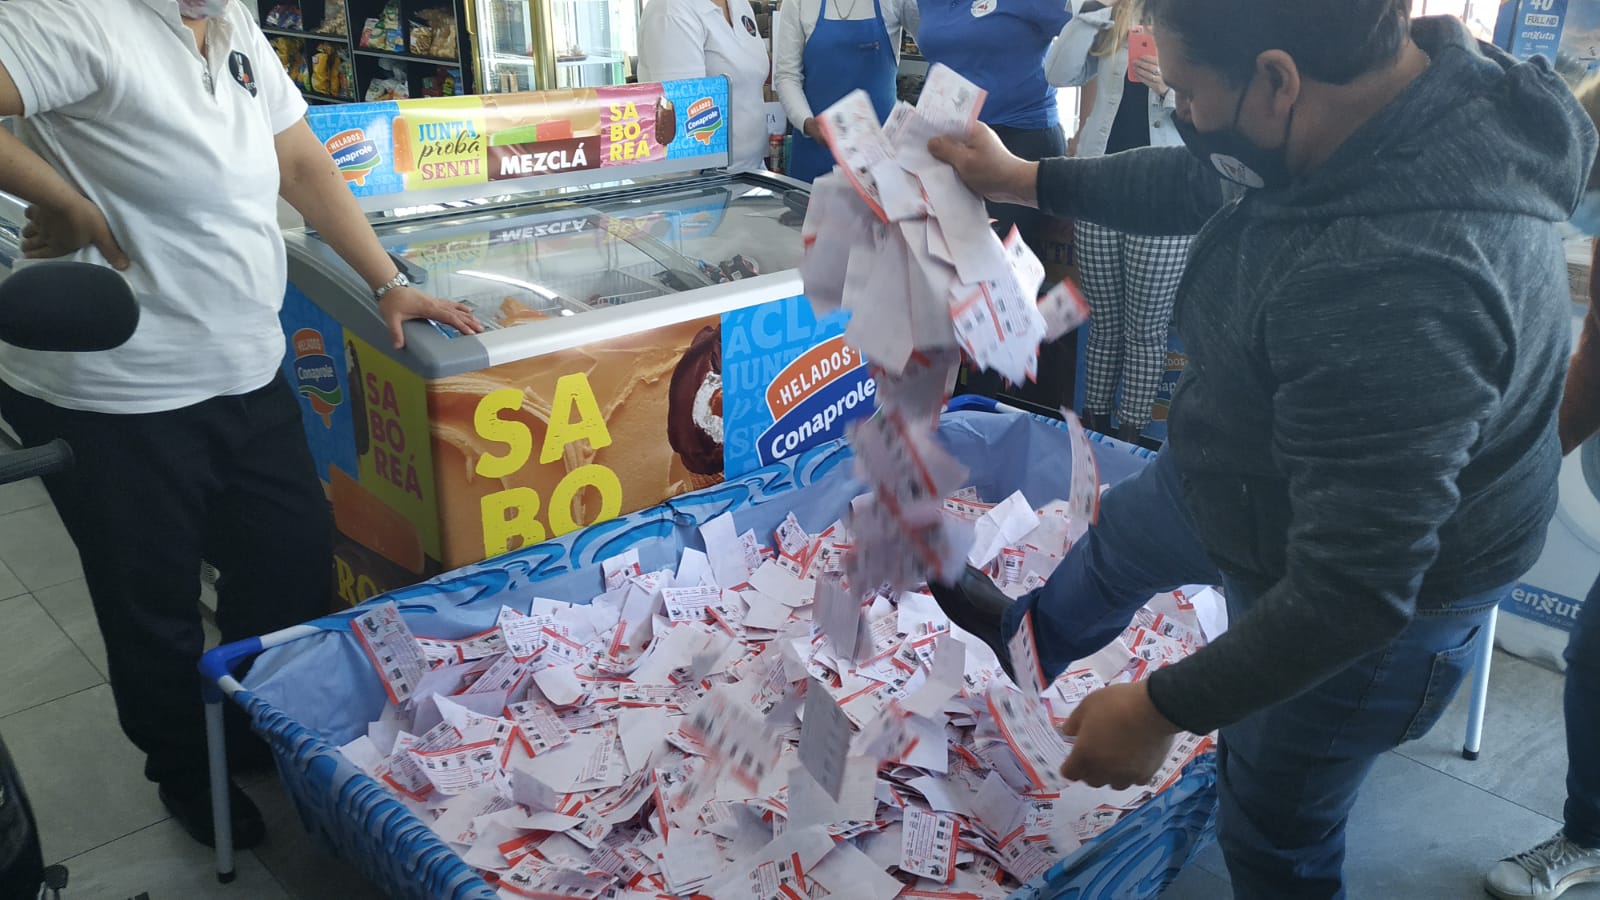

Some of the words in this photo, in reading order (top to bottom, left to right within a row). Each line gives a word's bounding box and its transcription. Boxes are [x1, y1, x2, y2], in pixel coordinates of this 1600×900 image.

[1526, 15, 1545, 25] FULL
[609, 101, 639, 122] SA
[687, 110, 718, 130] Conaprole
[330, 132, 360, 149] HELADOS
[418, 120, 476, 142] JUNTA
[610, 121, 641, 141] BO
[610, 134, 650, 161] REÁ
[334, 145, 373, 165] onaprole
[417, 130, 481, 169] probá
[500, 143, 588, 176] MEZCLÁ
[421, 159, 481, 181] SENTI
[779, 346, 851, 406] HELADOS
[366, 373, 399, 417] SA
[370, 411, 405, 454] BO
[474, 372, 612, 478] SA
[771, 378, 876, 459] Conaprole
[375, 447, 423, 501] REÁ
[481, 464, 623, 560] BO
[1511, 587, 1582, 620] enxut
